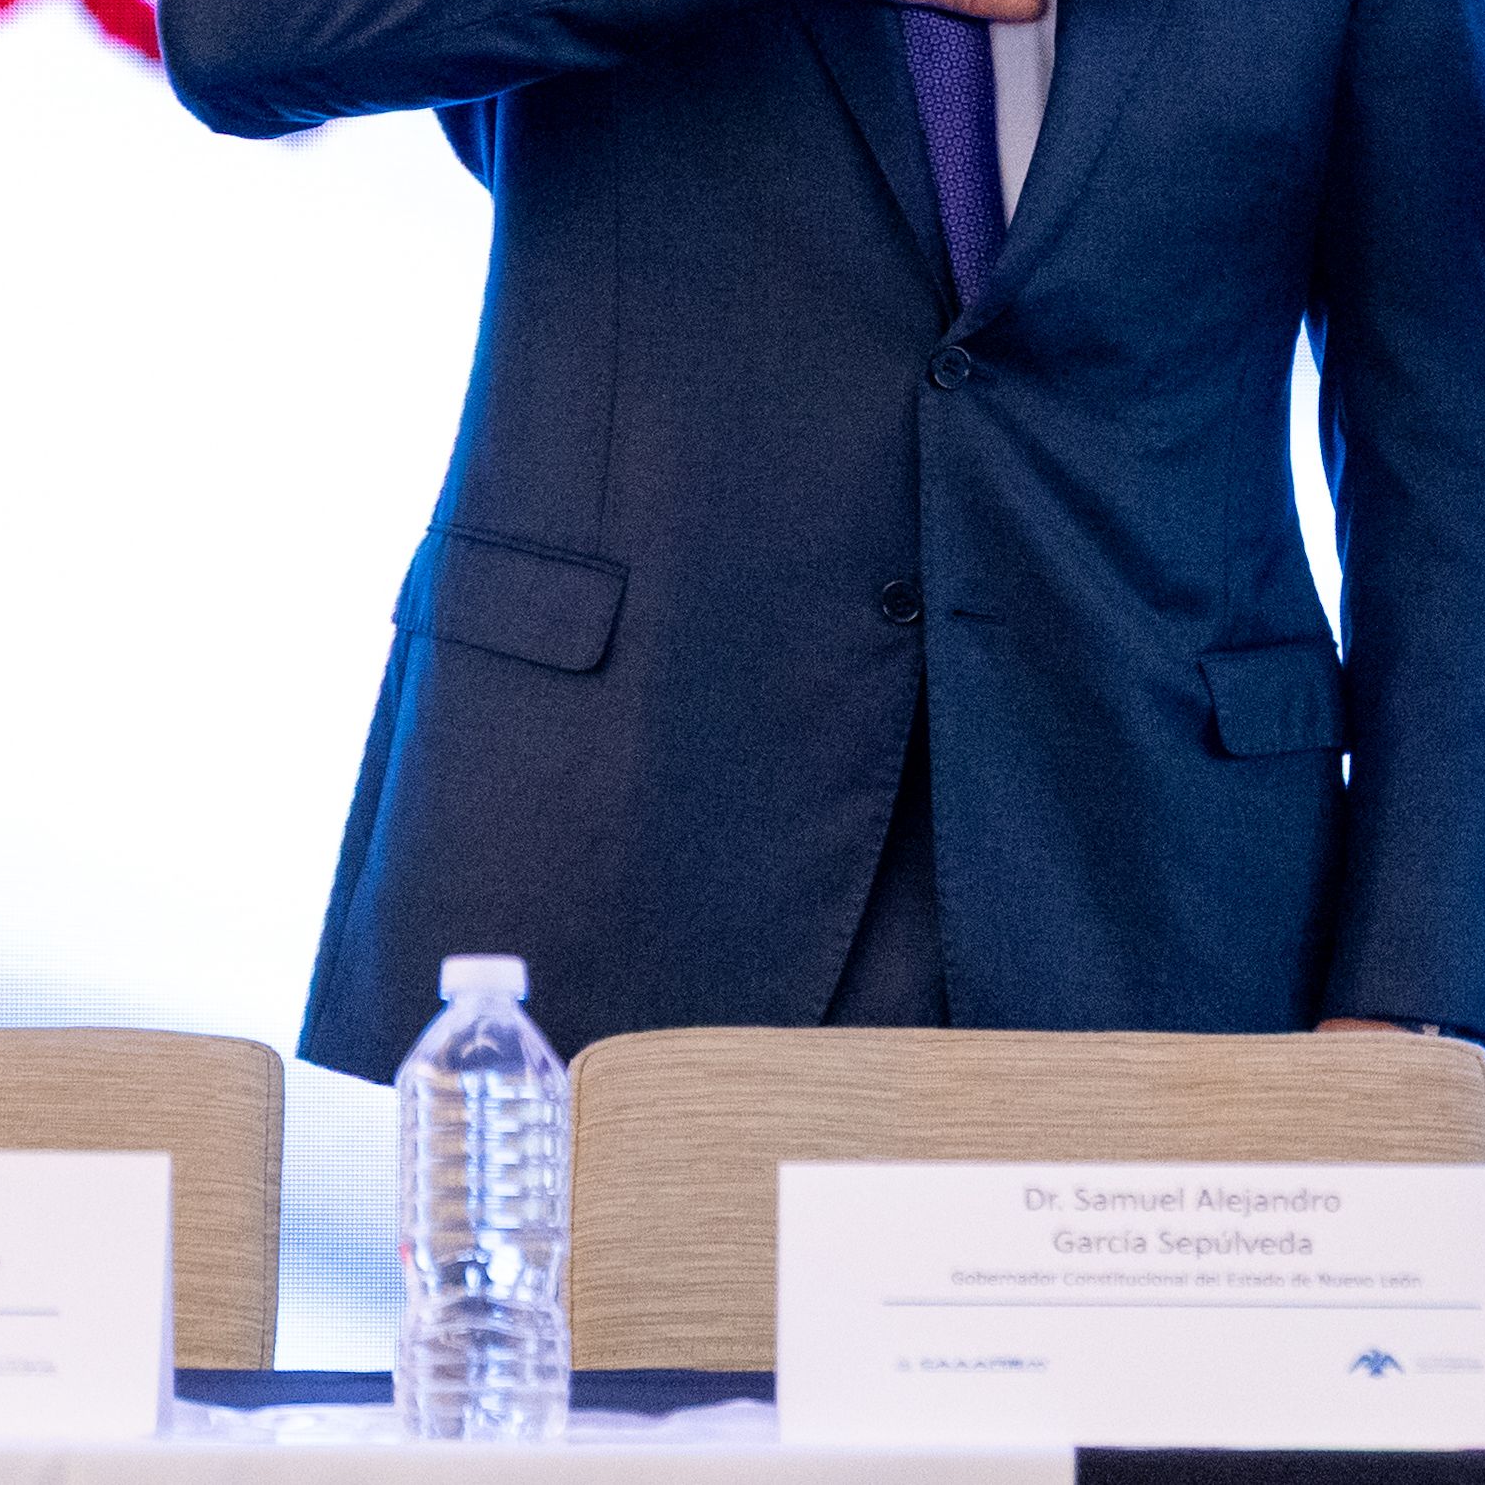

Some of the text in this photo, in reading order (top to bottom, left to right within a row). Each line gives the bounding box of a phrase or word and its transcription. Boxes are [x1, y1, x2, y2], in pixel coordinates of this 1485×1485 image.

[1022, 1185, 1343, 1218] Dr. Samuel Alejandro
[1051, 1227, 1314, 1259] García Sepúlveda
[950, 1269, 1058, 1286] Gobernador
[1063, 1269, 1188, 1287] Constitucional
[1194, 1271, 1220, 1287] del
[1226, 1271, 1286, 1288] Estado
[1290, 1271, 1313, 1288] de
[1317, 1271, 1374, 1288] Nuevo
